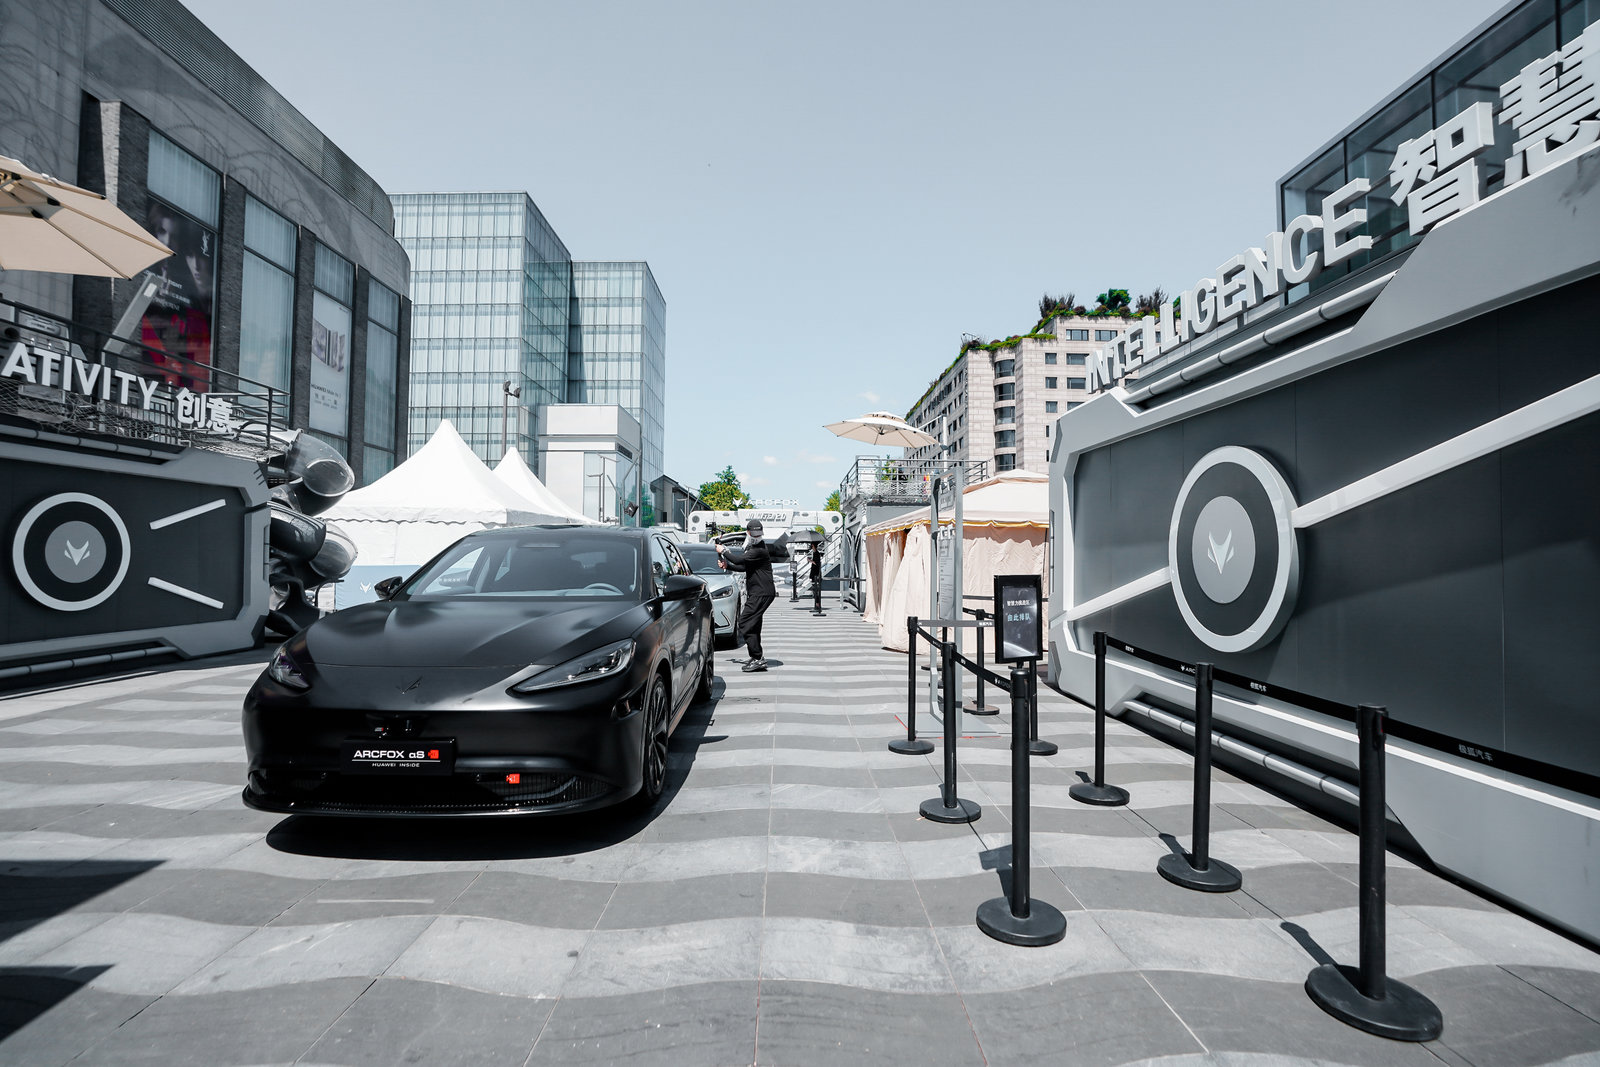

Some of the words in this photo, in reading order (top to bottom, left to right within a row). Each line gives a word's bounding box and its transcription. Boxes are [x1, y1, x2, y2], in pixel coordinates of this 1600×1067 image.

[1086, 177, 1373, 394] INTELLIGENCE
[1, 342, 158, 411] ATIVITY
[176, 387, 237, 434] 创意
[353, 750, 405, 759] ARCFOX
